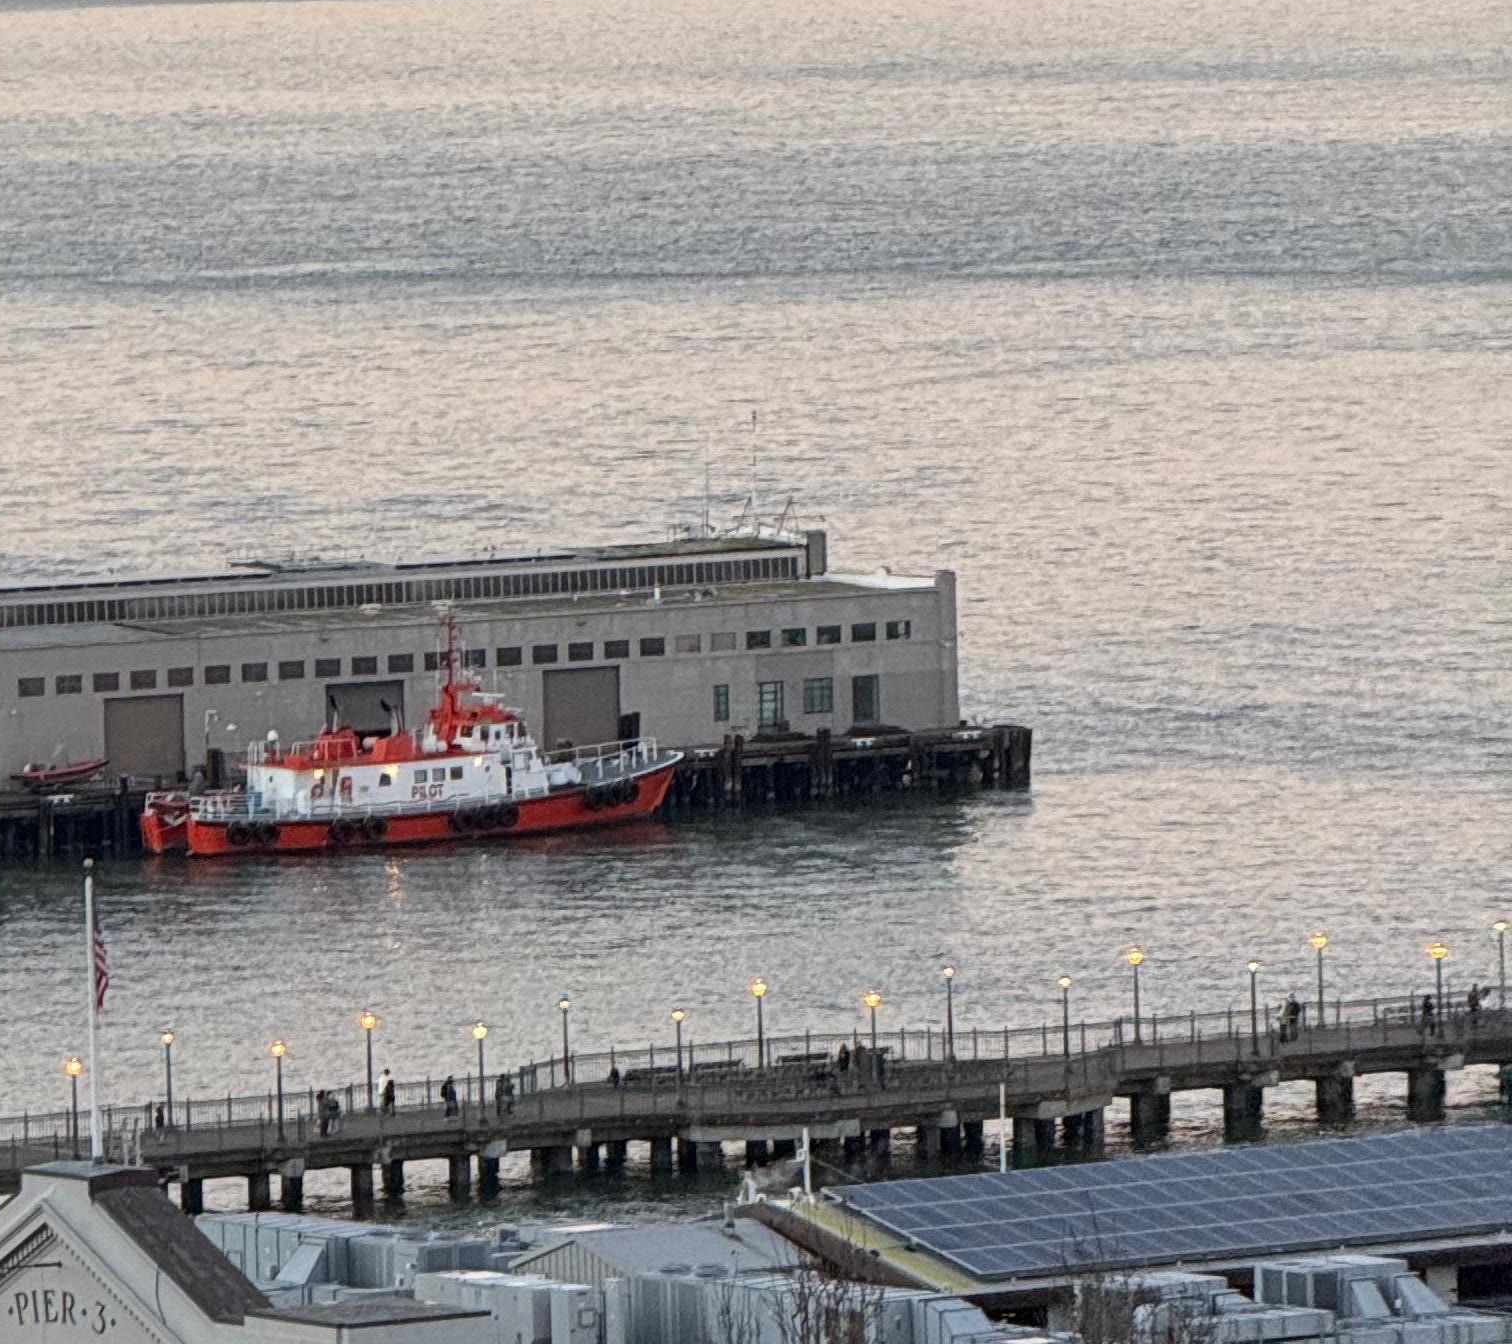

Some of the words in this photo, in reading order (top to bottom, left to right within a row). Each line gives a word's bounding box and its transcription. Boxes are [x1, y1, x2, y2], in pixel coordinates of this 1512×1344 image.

[411, 783, 444, 799] PILOT
[14, 1289, 77, 1326] PIER
[91, 1300, 106, 1335] 3
